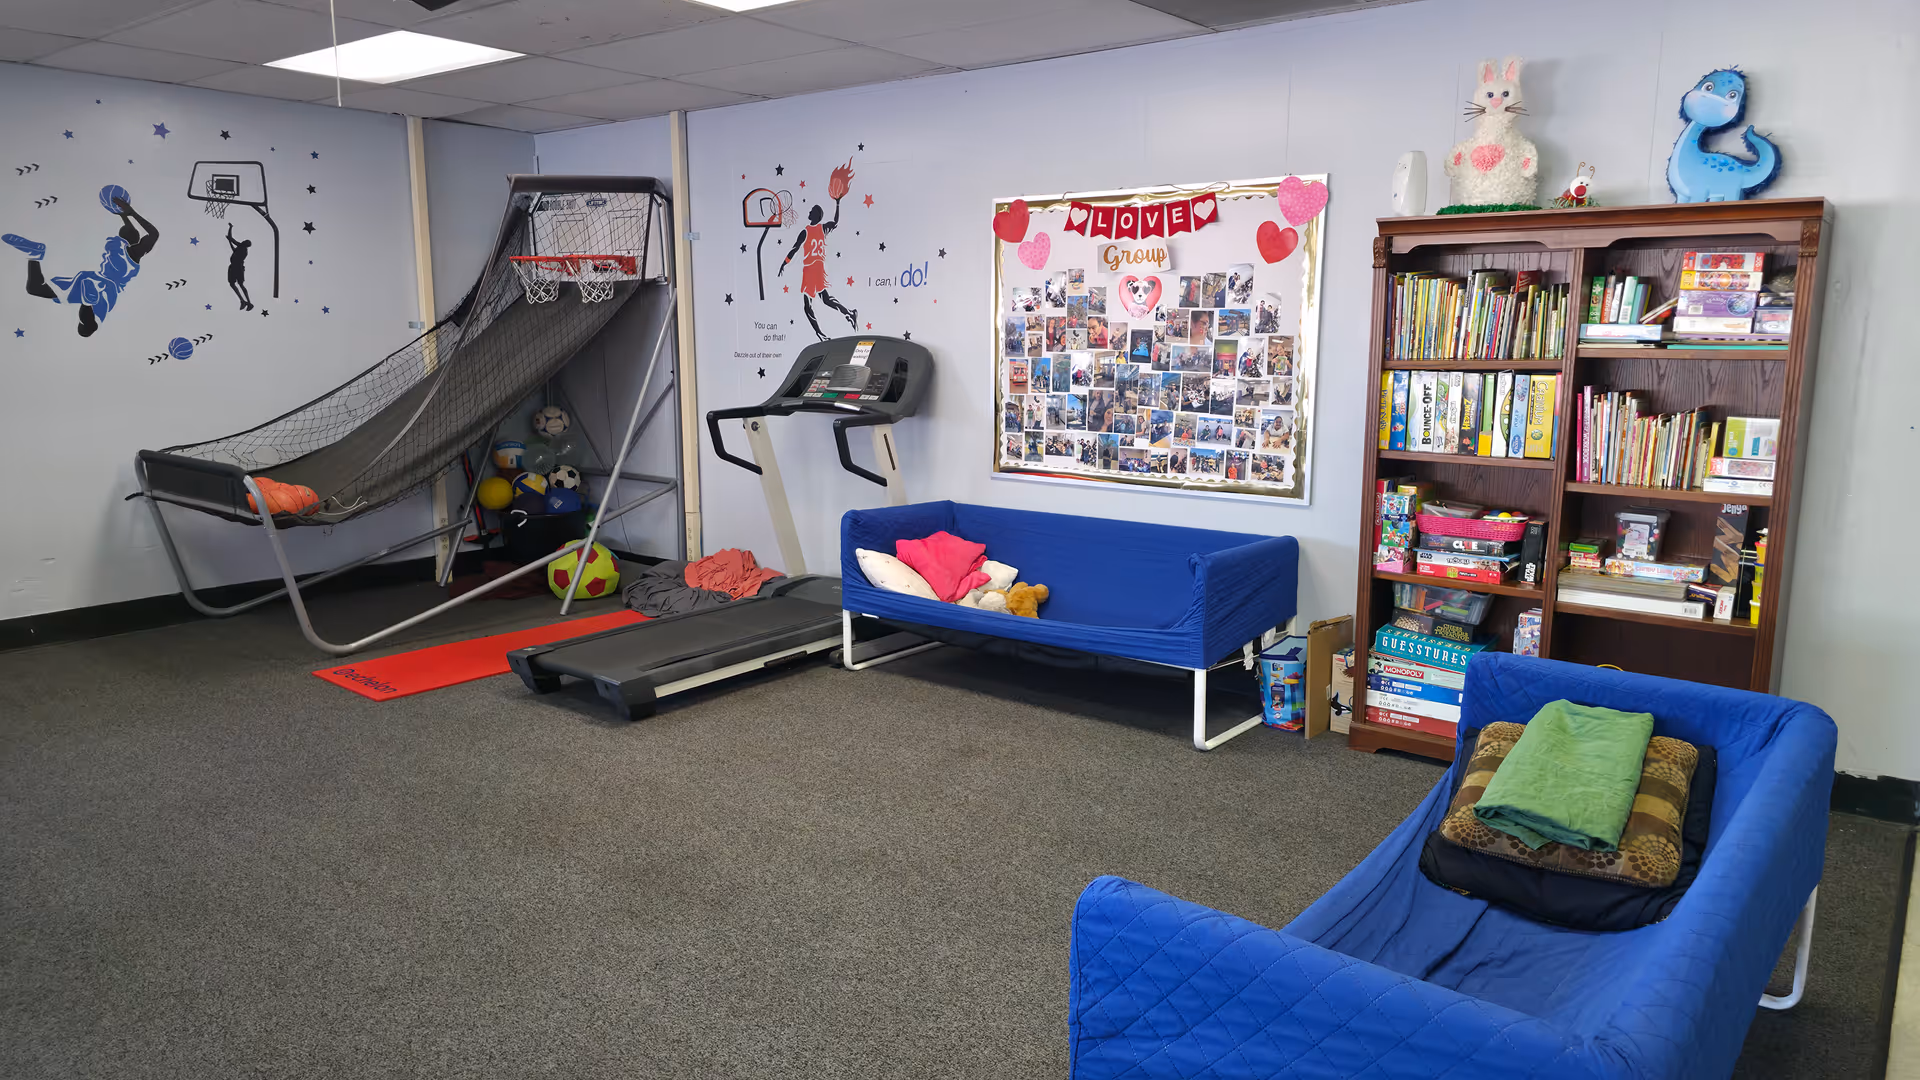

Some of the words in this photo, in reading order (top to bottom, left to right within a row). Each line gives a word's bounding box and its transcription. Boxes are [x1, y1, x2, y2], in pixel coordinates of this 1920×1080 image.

[1097, 206, 1184, 229] LOVE
[811, 238, 824, 256] 23
[1103, 245, 1168, 271] Group
[875, 278, 891, 287] can,
[900, 261, 928, 288] do!
[754, 321, 766, 330] You
[766, 323, 777, 331] can
[1721, 503, 1748, 515] Jenga
[1452, 540, 1478, 550] CLUE
[1382, 636, 1467, 666] GUESSTURES
[1384, 666, 1423, 678] MONOPOLY
